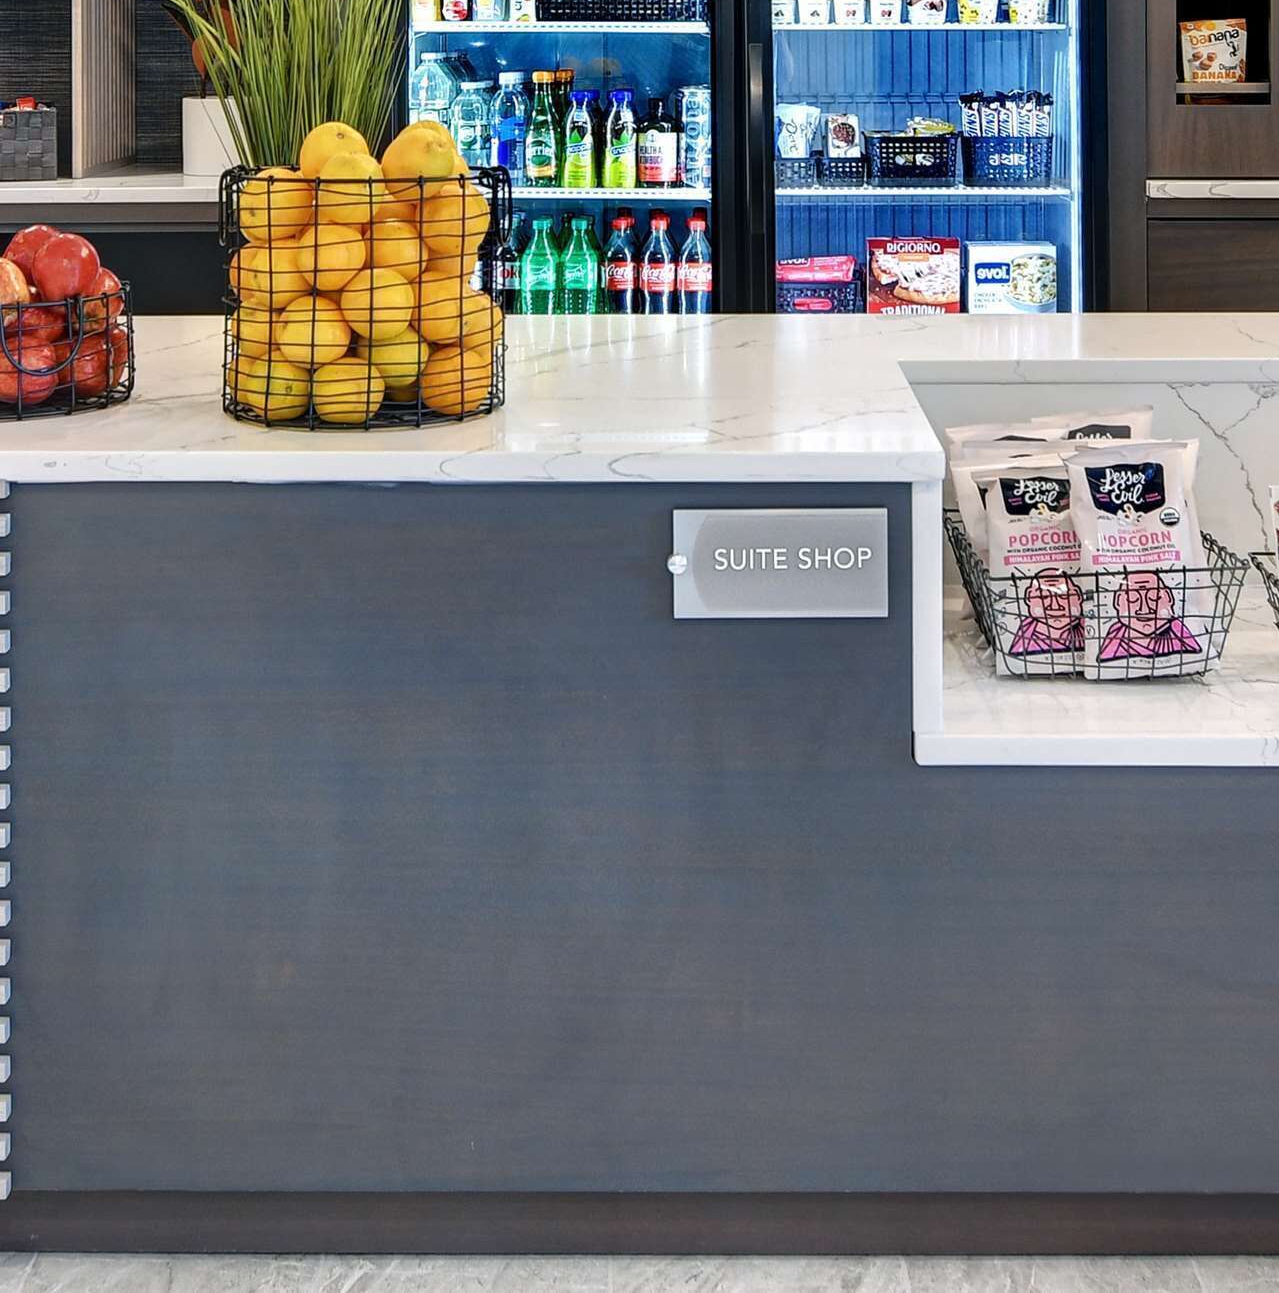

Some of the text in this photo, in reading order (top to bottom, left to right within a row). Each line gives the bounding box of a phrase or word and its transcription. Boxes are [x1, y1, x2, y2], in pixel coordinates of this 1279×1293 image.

[1104, 531, 1172, 547] OPCORN
[714, 547, 872, 571] SUITE SHOP
